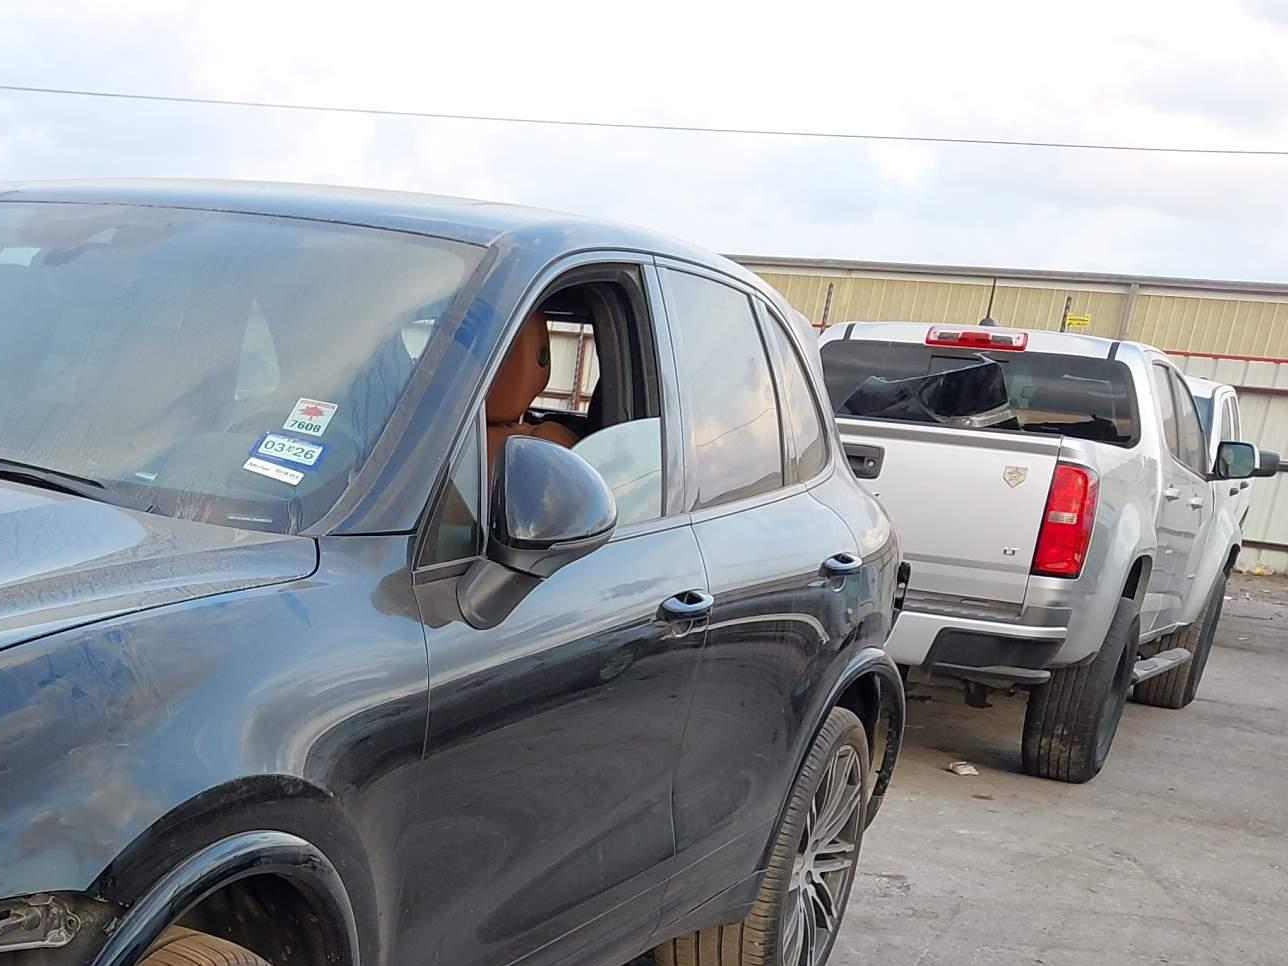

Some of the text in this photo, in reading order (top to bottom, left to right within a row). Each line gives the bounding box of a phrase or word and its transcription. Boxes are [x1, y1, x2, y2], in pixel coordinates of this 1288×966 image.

[290, 420, 321, 433] 7608
[264, 440, 316, 460] 03 26
